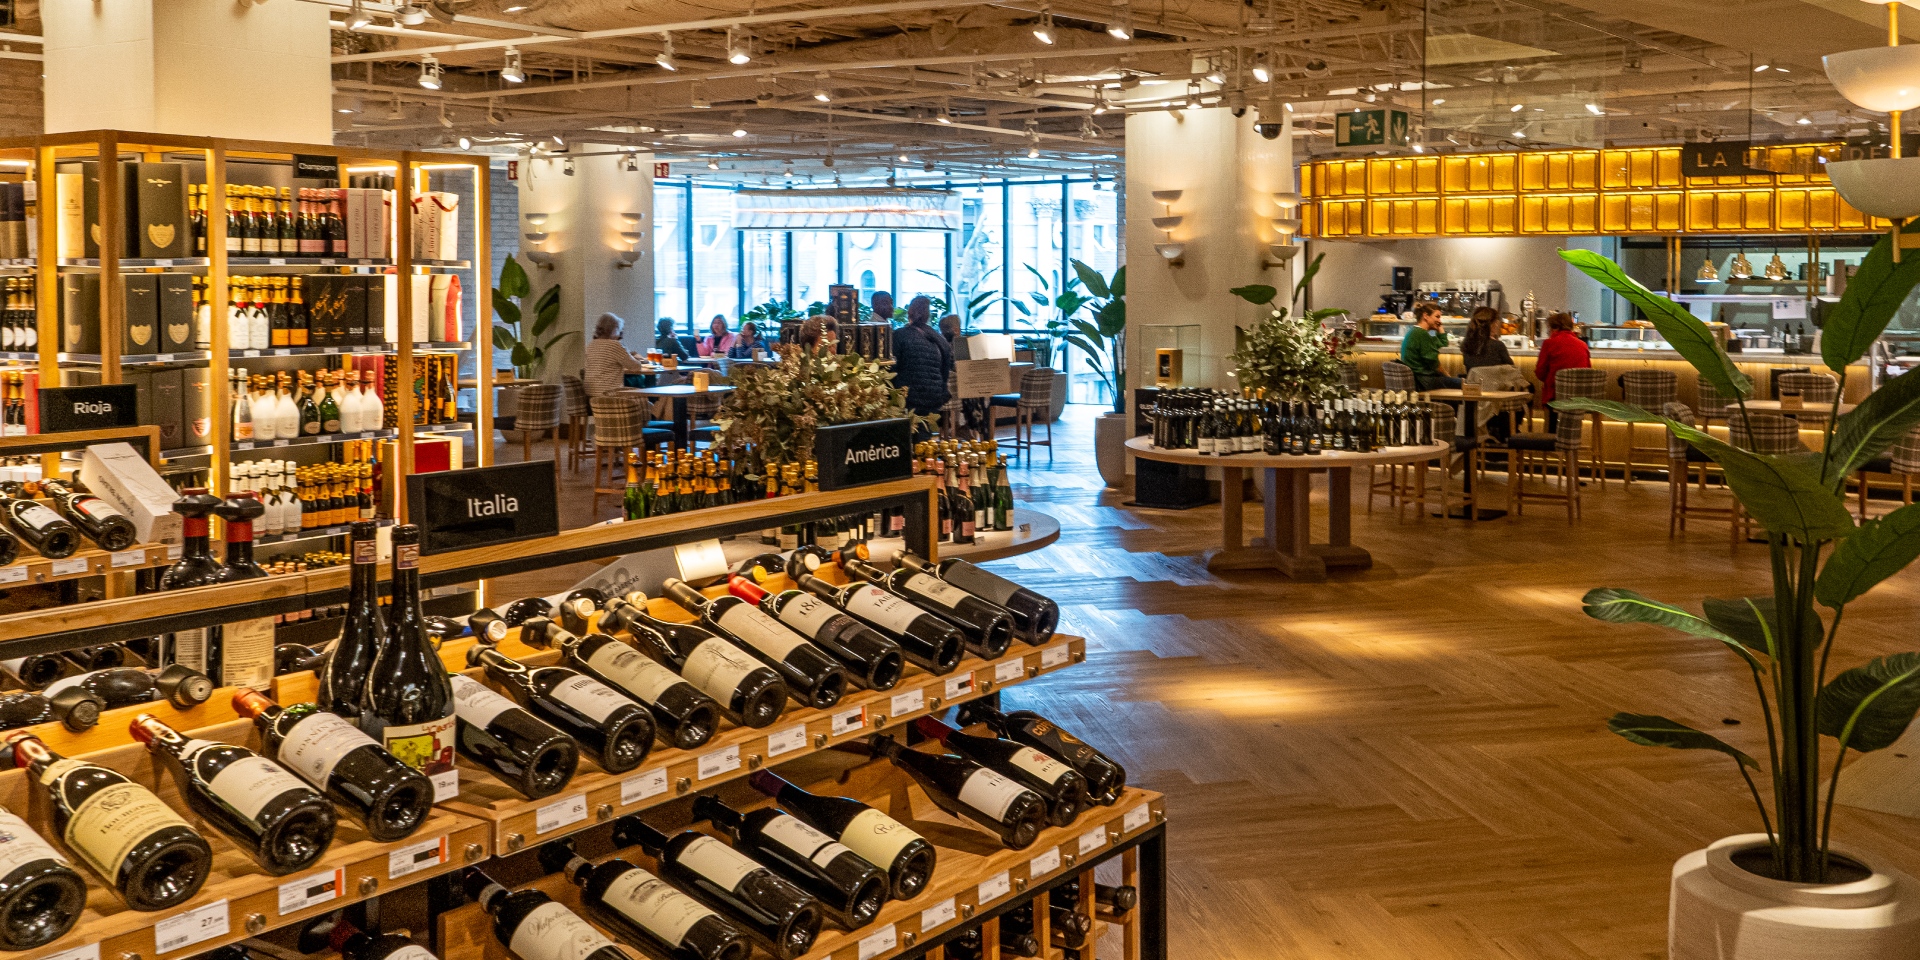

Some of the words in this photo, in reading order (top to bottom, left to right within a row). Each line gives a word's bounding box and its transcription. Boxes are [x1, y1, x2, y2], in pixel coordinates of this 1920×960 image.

[298, 162, 337, 172] Champagne
[1697, 151, 1728, 168] LA
[73, 401, 112, 415] Rioja
[844, 443, 900, 465] América
[467, 493, 519, 518] Italia
